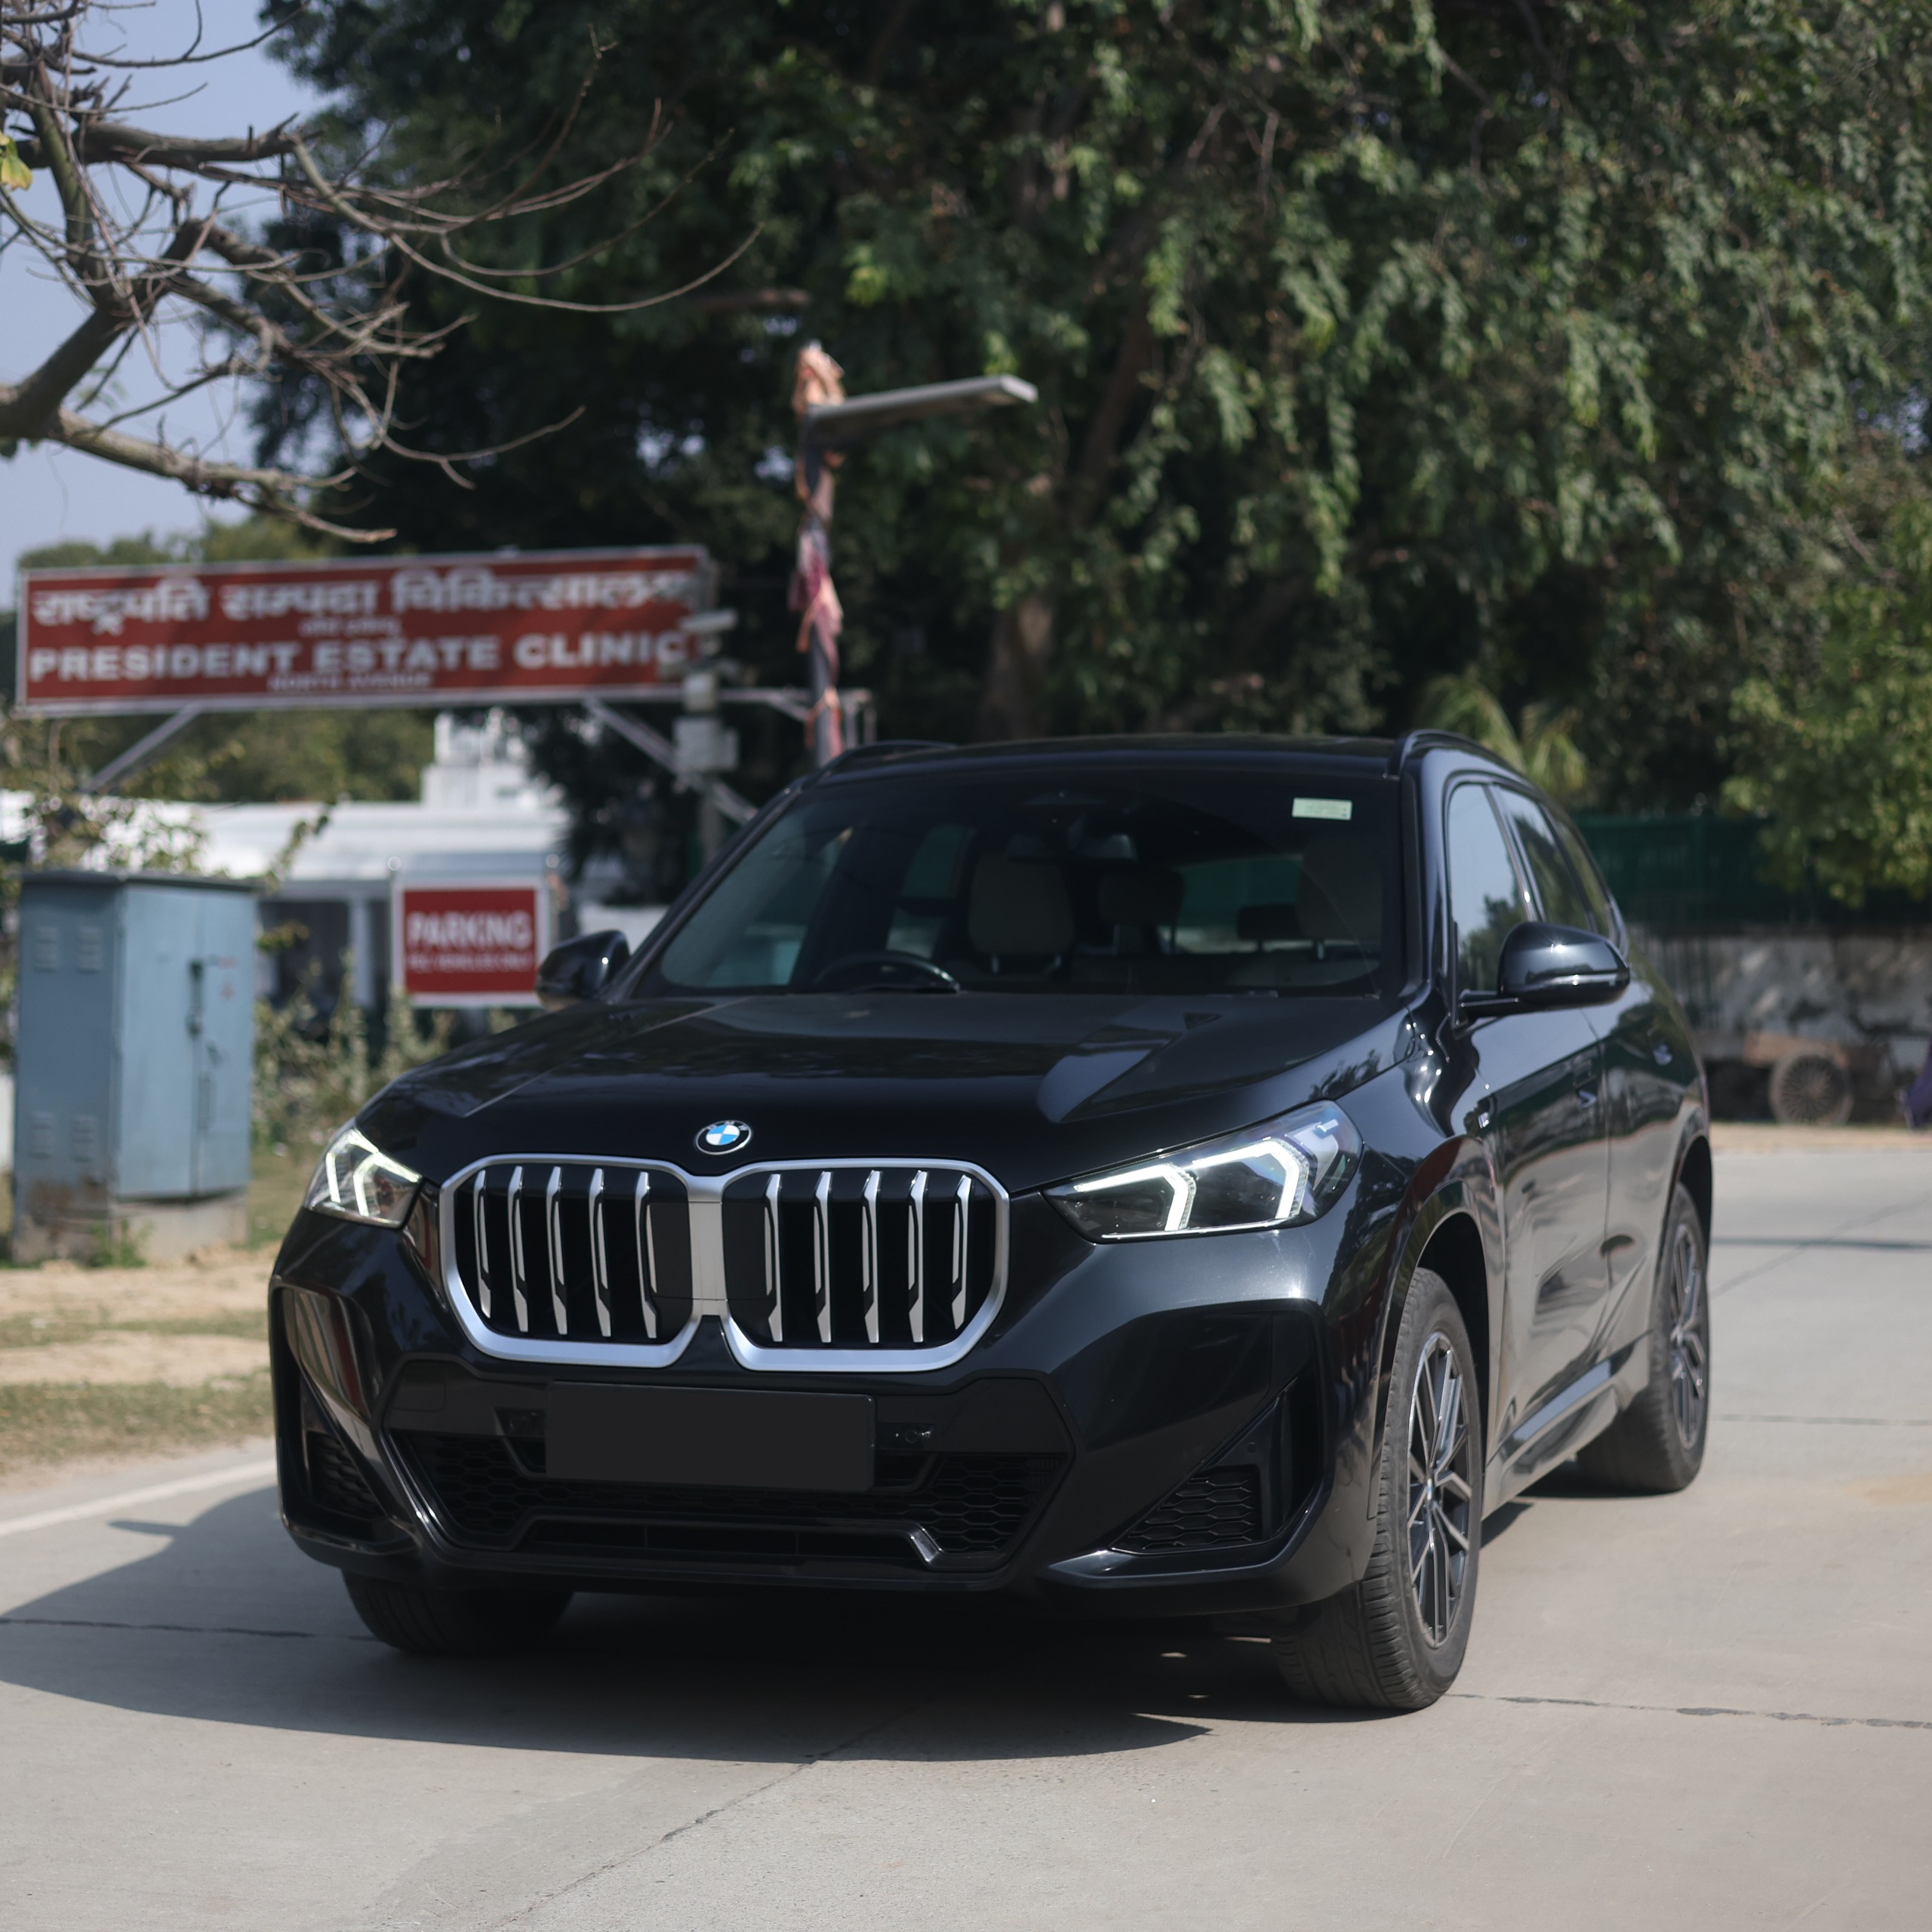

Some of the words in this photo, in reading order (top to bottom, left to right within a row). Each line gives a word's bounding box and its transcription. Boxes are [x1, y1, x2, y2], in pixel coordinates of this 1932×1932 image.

[29, 641, 301, 682] PRESIDENT
[312, 634, 500, 674] ESTATE
[513, 630, 687, 669] CLINIC
[407, 911, 531, 950] PARKING
